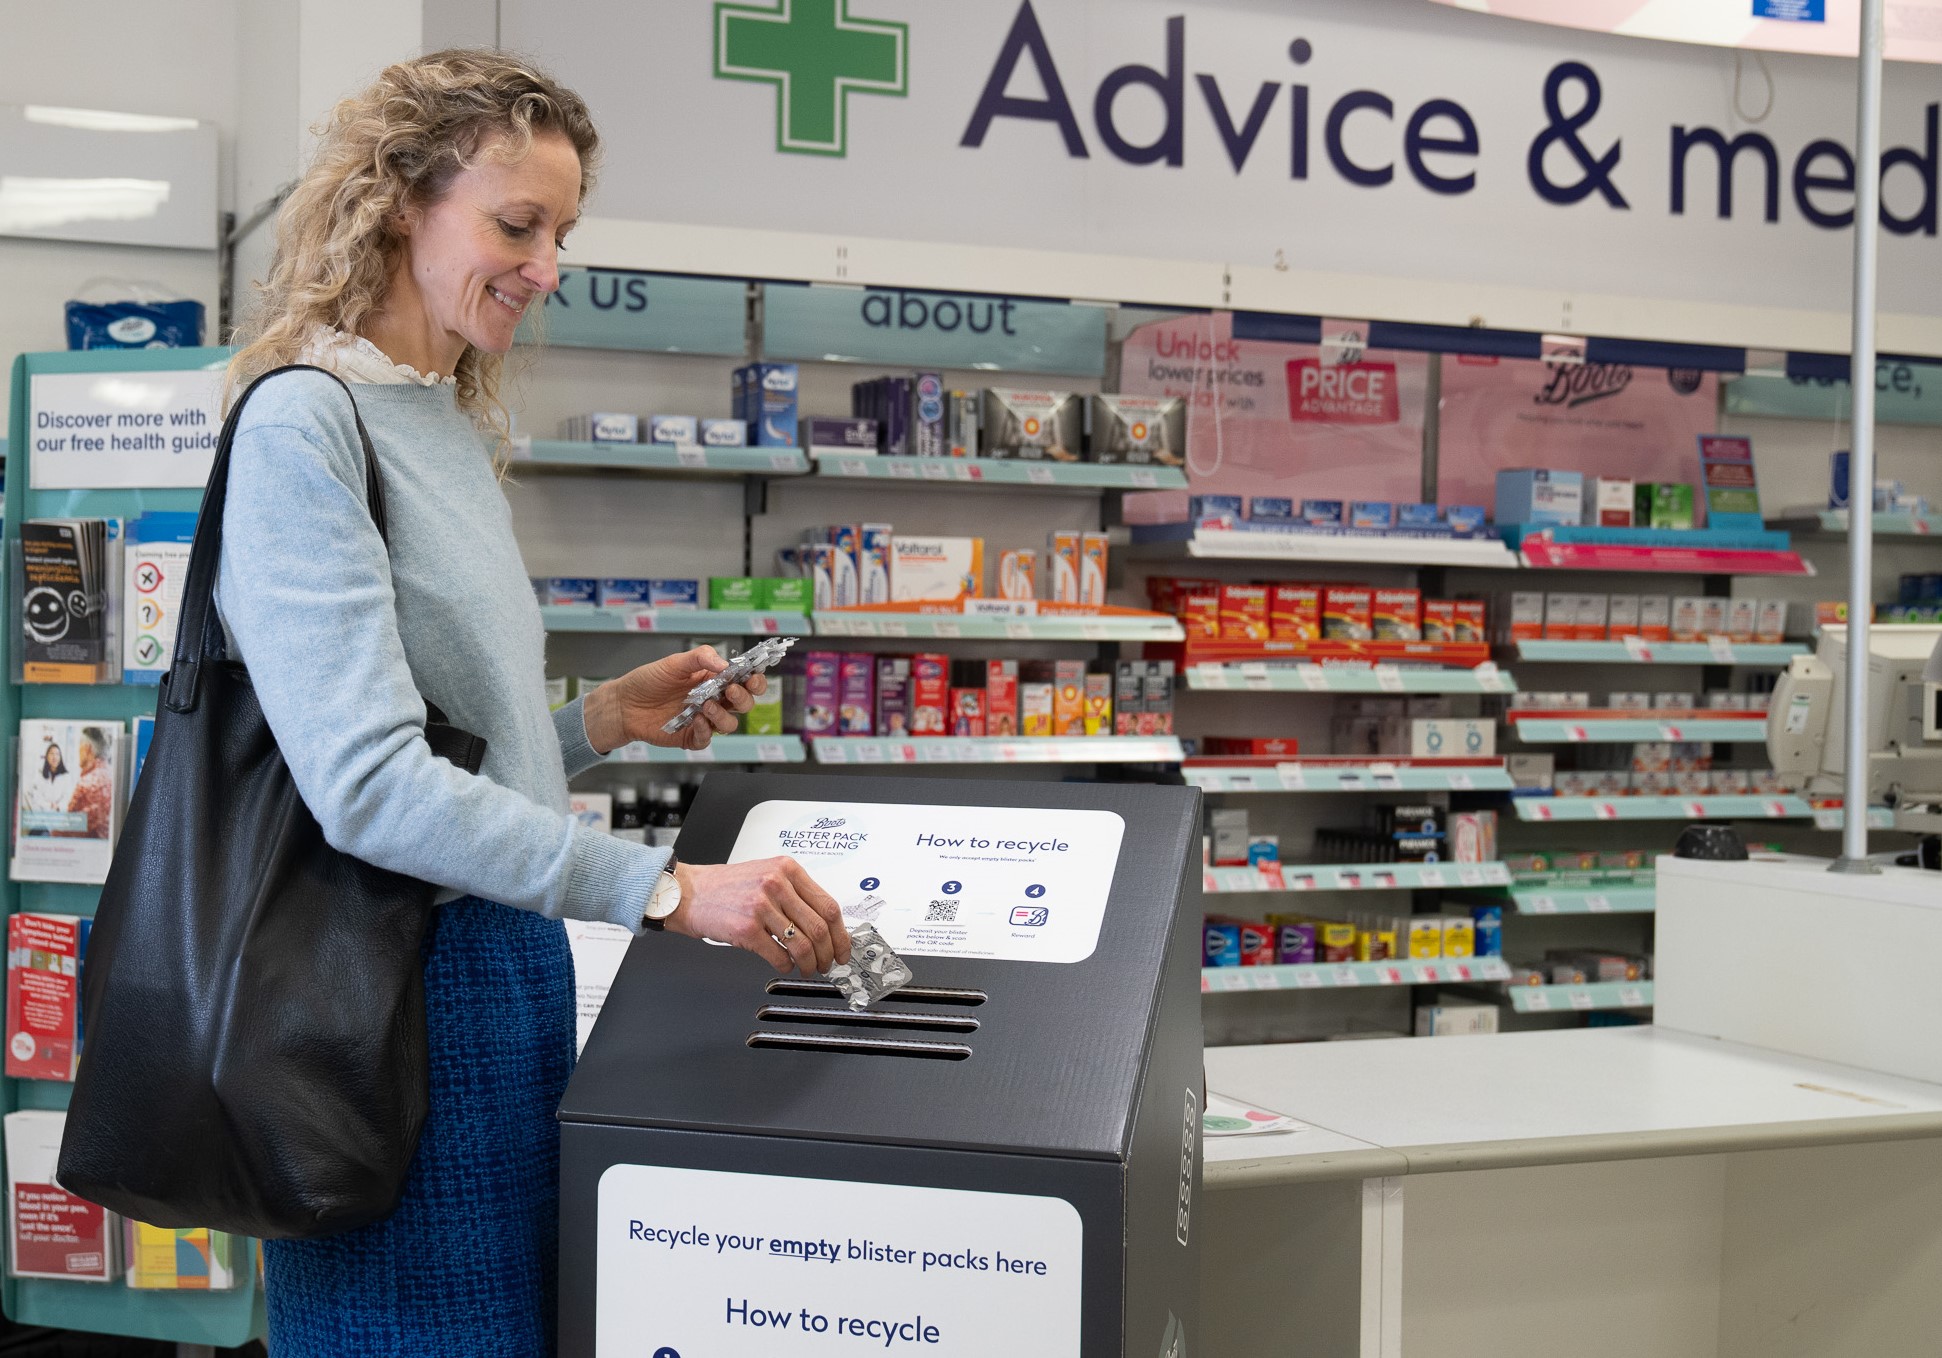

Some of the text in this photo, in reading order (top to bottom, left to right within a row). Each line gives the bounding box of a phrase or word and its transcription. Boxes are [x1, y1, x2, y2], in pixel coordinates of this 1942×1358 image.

[958, 0, 1940, 237] Advice & med
[861, 290, 1016, 336] about
[1156, 329, 1240, 362] Unlock
[1300, 366, 1386, 401] PRICE
[1301, 400, 1382, 416] ADVANTAGE
[37, 409, 206, 429] Discover more with
[37, 437, 65, 451] our
[71, 435, 104, 450] free
[111, 433, 165, 450] health
[896, 542, 944, 556] Voltarol
[811, 817, 846, 830] Boots
[779, 830, 868, 842] BLISTER PACK
[916, 834, 1069, 854] How to recycle
[782, 840, 859, 850] RECYCLING
[865, 880, 874, 889] 2
[946, 883, 956, 892] 3
[1030, 886, 1040, 895] 4
[26, 1193, 40, 1202] you
[51, 1204, 69, 1214] your
[628, 1220, 1048, 1277] Recycle your empty blister packs here
[726, 1298, 941, 1346] How to recycle
